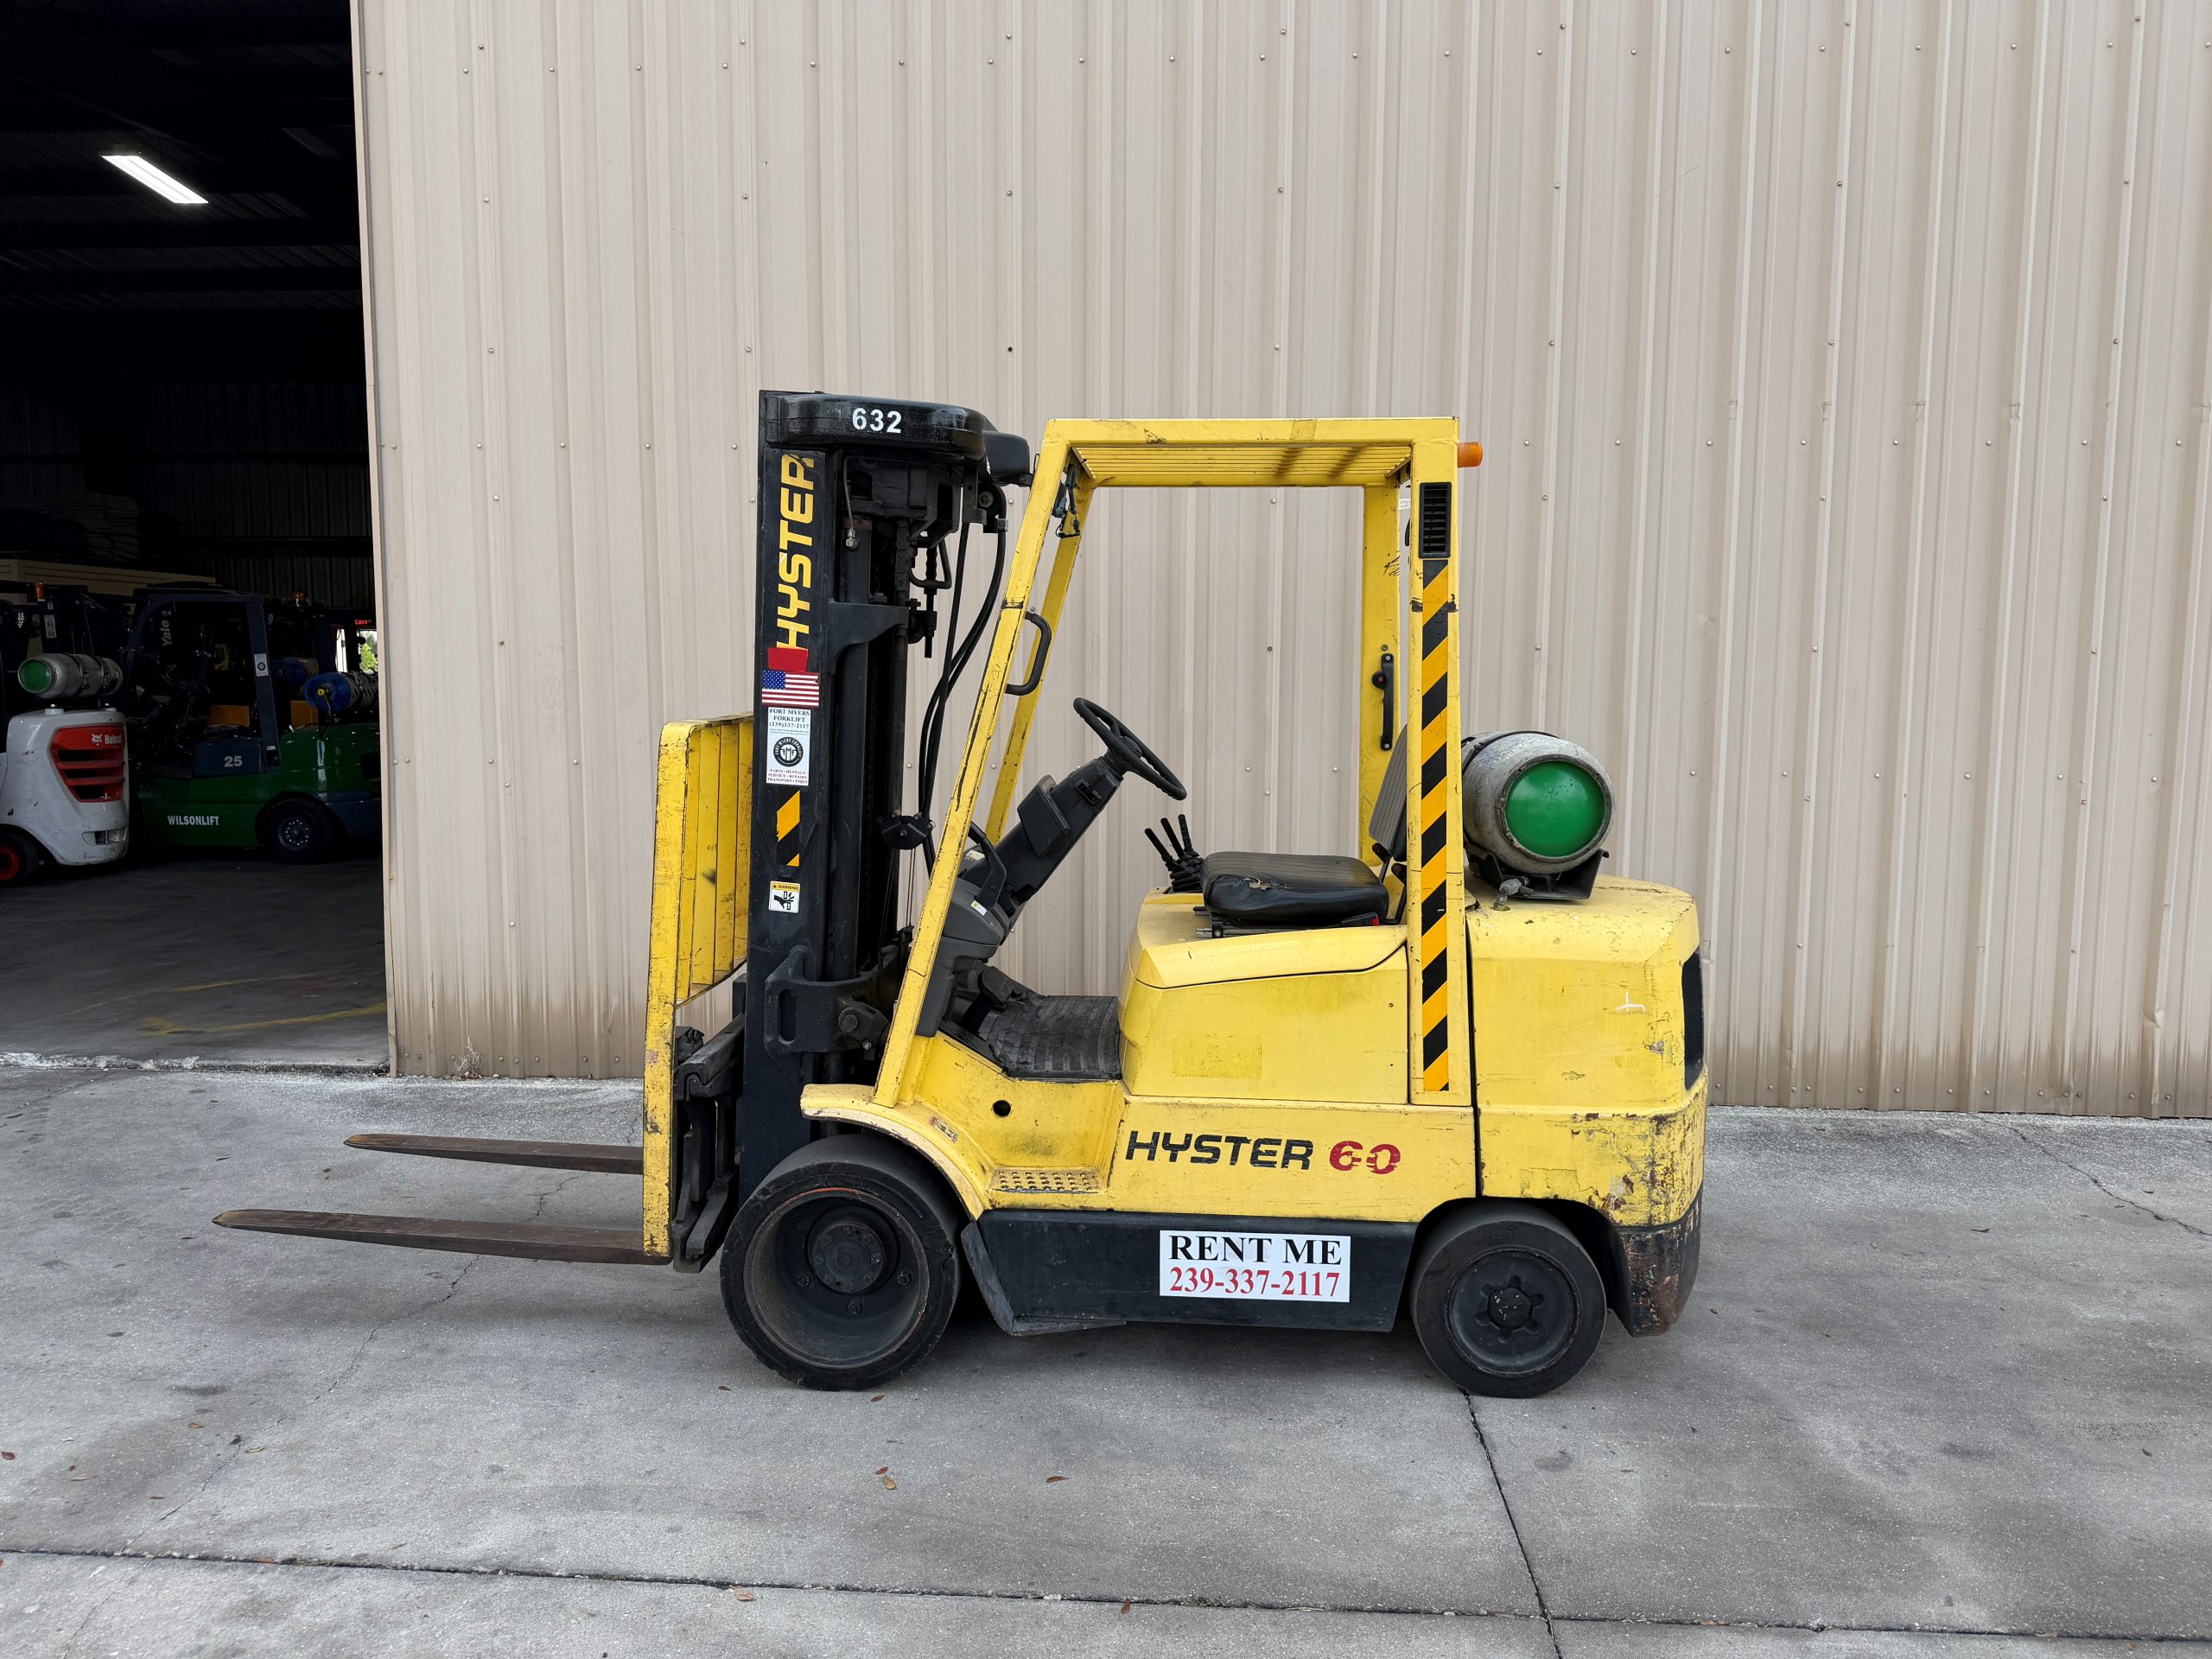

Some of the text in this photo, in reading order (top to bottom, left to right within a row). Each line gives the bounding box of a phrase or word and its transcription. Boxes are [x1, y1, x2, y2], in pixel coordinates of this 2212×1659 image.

[852, 407, 901, 434] 632
[776, 454, 815, 649] HYSTER
[160, 620, 173, 647] Yale
[224, 755, 243, 767] 25
[167, 815, 219, 826] WILSONLIFT
[1125, 1130, 1402, 1175] HYSTER 60
[1168, 1235, 1342, 1266] RENT ME
[1169, 1266, 1340, 1297] 239-337-2117
